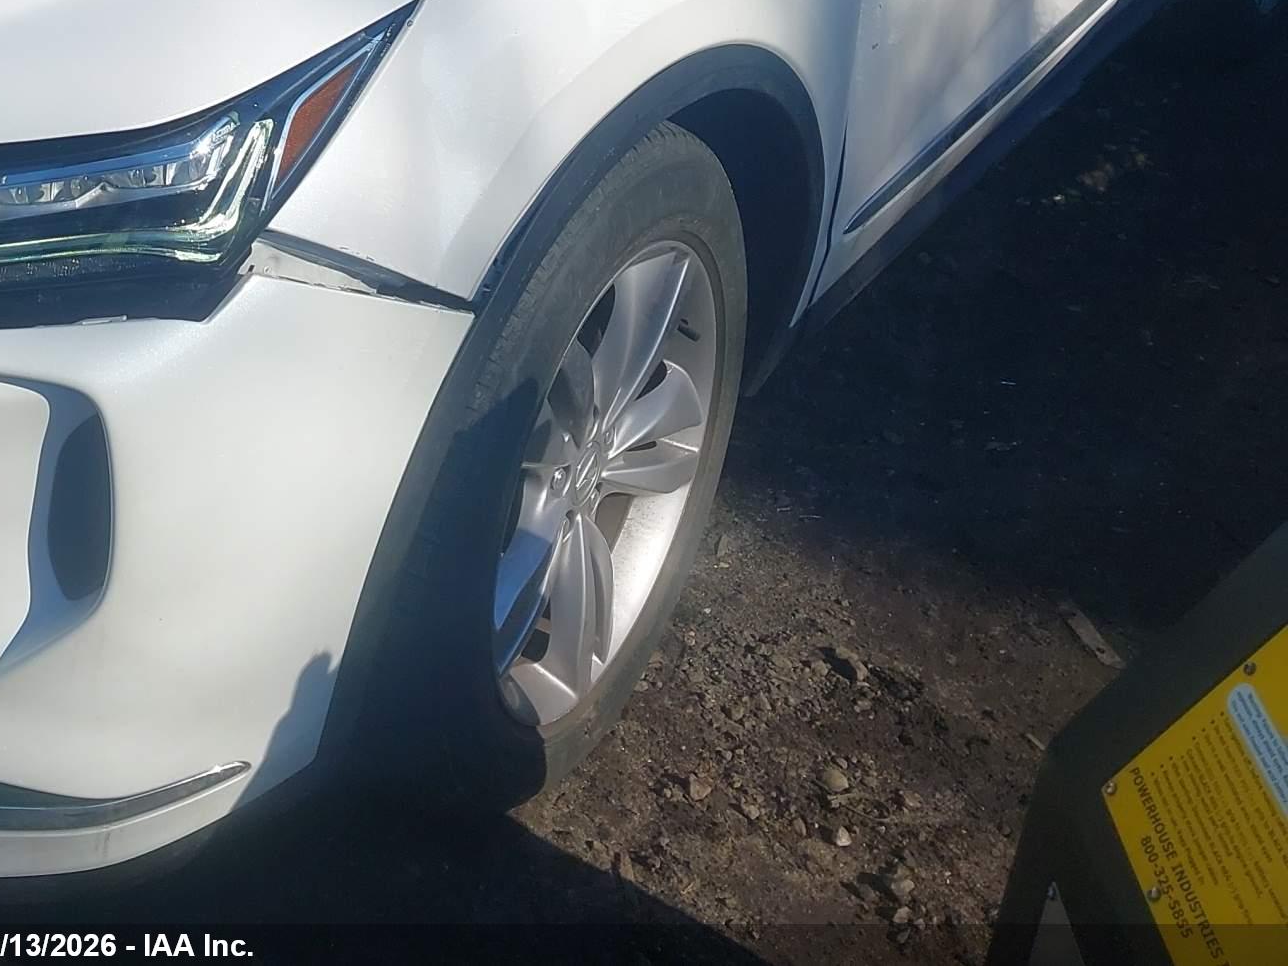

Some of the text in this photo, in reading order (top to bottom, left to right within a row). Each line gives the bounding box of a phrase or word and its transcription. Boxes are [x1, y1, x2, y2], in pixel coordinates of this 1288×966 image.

[1130, 767, 1177, 861] POWERHOUSE
[1172, 862, 1224, 960] INDUSTRIES
[1140, 835, 1193, 939] 800-325-5855
